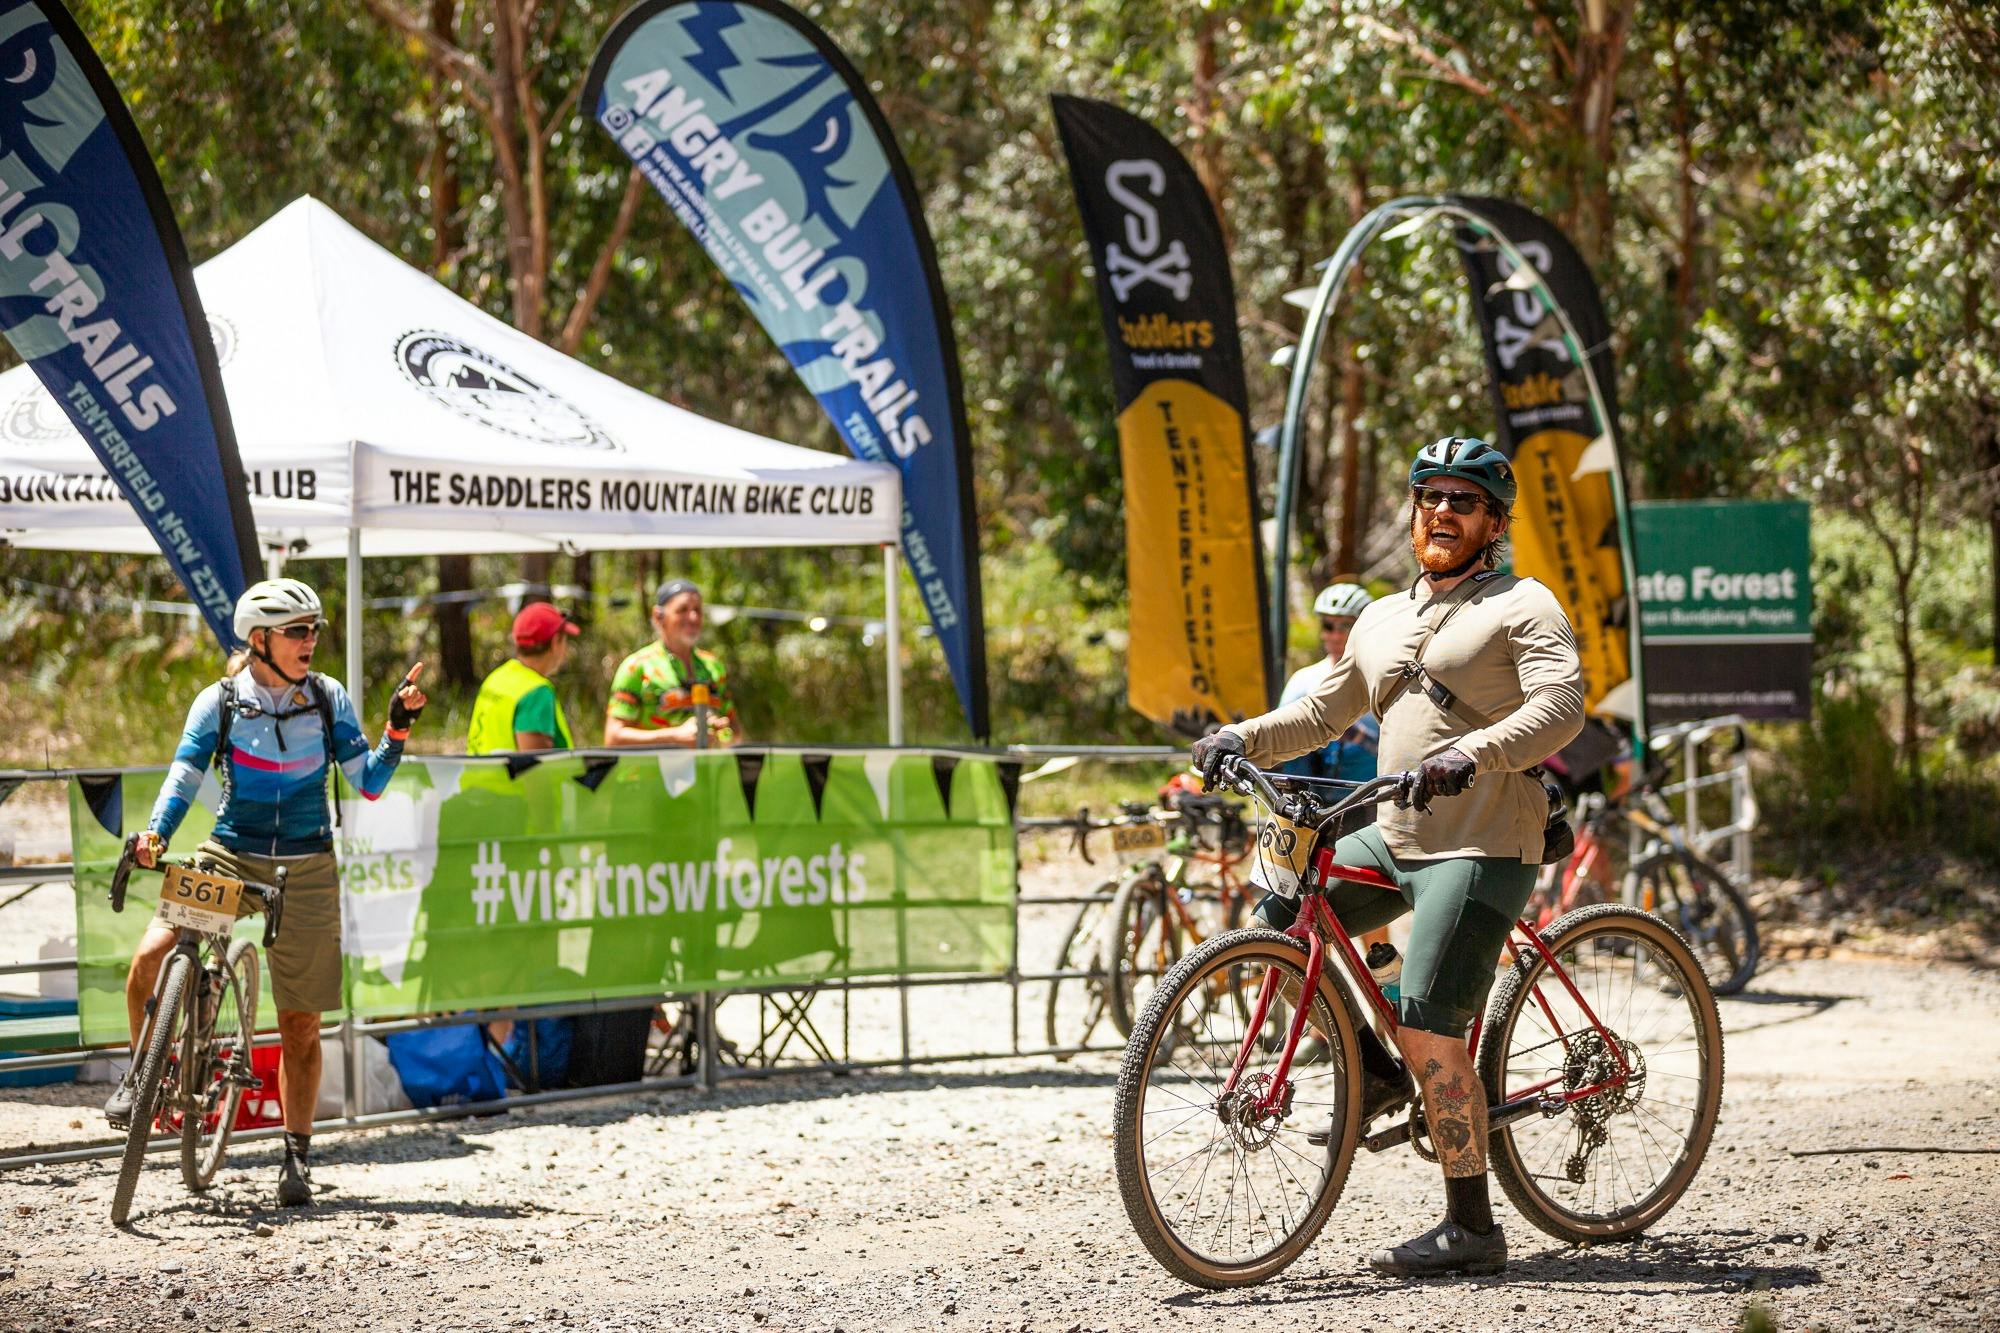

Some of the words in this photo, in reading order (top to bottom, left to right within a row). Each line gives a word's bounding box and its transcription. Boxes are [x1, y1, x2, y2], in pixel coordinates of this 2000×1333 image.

[622, 68, 764, 200] ANGRY
[739, 197, 838, 311] BULL
[821, 302, 932, 459] TRAILS
[29, 250, 177, 431] TRAILS
[67, 380, 167, 517] TENTERFIELD
[156, 506, 202, 567] NSW
[190, 562, 234, 621] 2372
[241, 469, 316, 501] LUB
[390, 469, 441, 505] THE
[448, 473, 591, 511] SADDLERS
[599, 480, 736, 515] MOUNTAIN
[743, 485, 803, 515] BIKE
[810, 485, 875, 516] CLUB
[904, 529, 938, 587] NSW
[925, 580, 959, 630] 2372
[1692, 566, 1797, 600] Forest
[177, 875, 226, 905] 561
[471, 837, 867, 925] #visitnswforests
